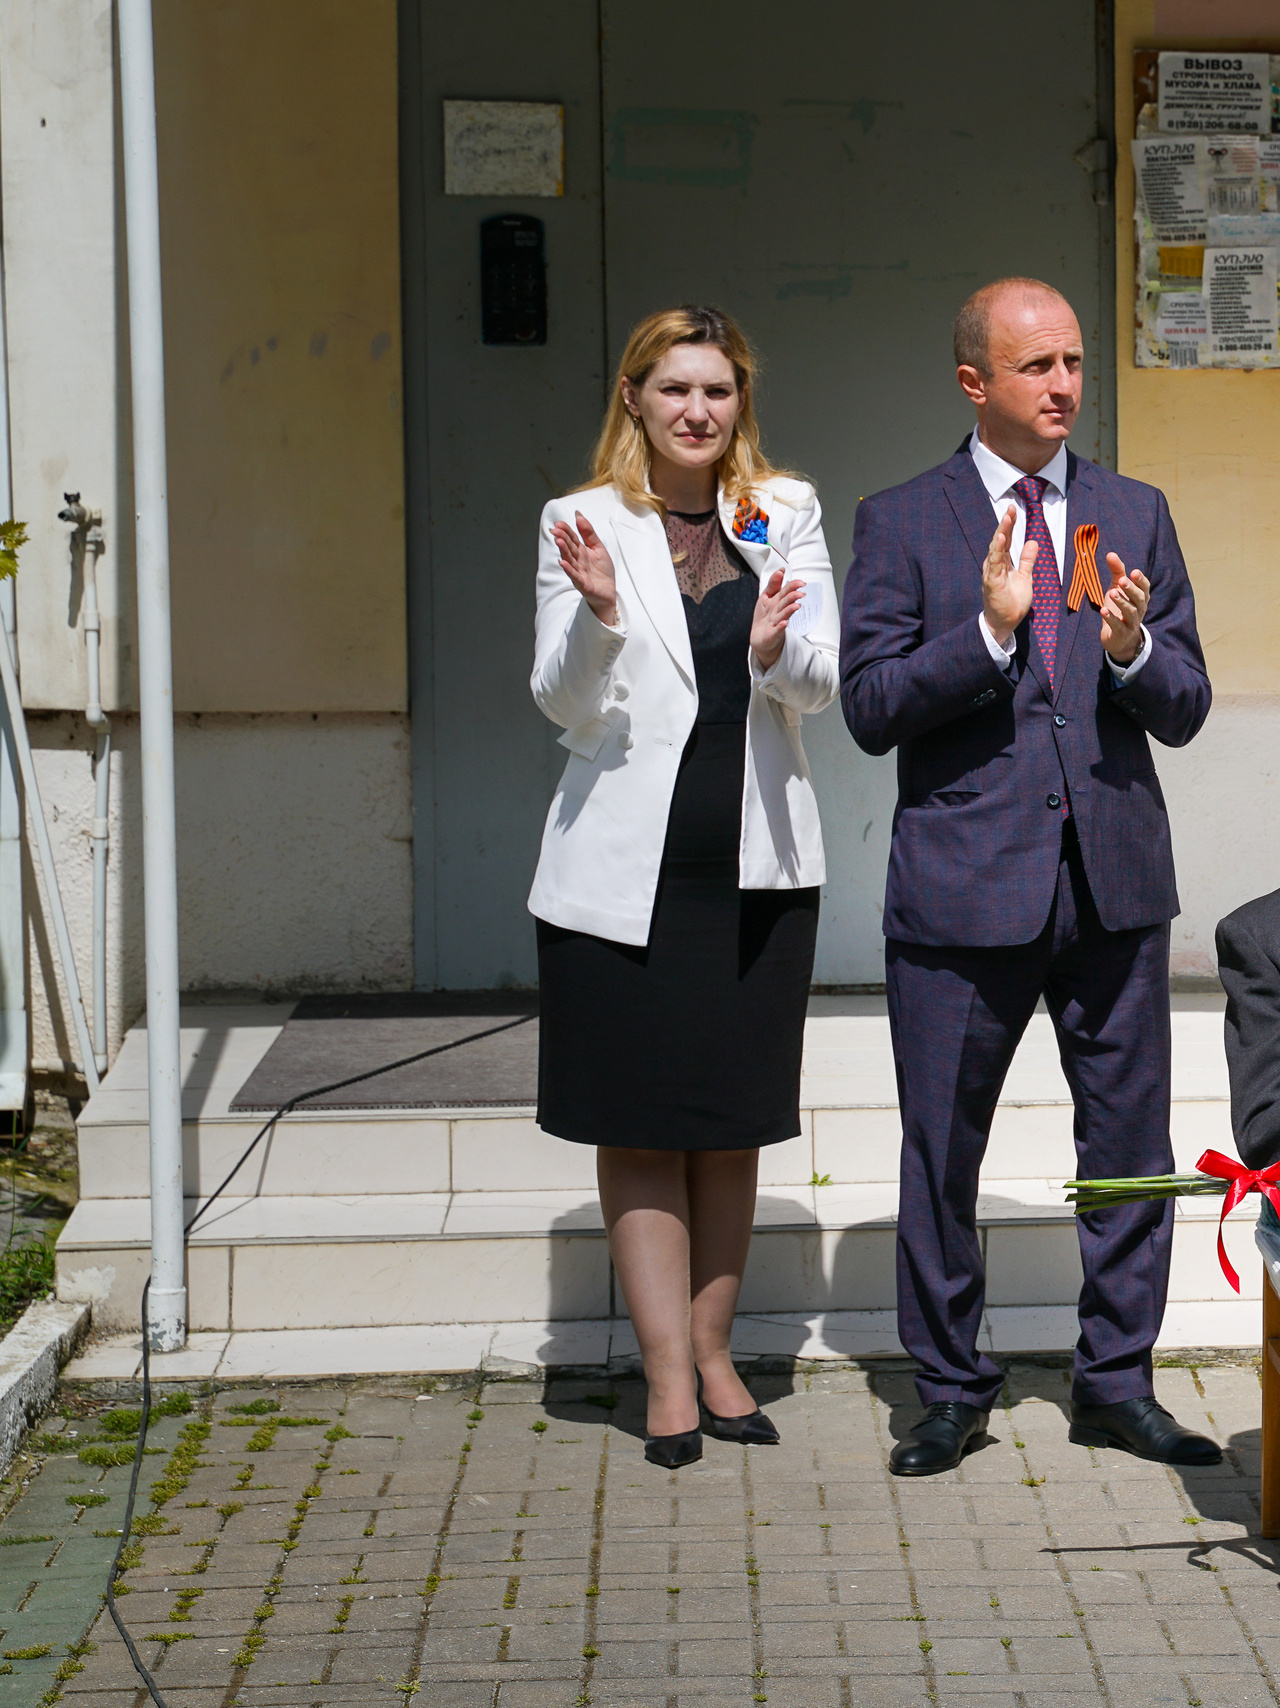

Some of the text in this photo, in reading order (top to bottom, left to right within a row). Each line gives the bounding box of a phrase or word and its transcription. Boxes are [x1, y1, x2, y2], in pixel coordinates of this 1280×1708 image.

[1184, 59, 1243, 71] ВЫВОЗ
[1172, 72, 1254, 80] СТРОИТЕЛЬНОГО
[1165, 80, 1210, 89] МУСОРА
[1223, 82, 1262, 90] ХЛАМА
[1213, 253, 1264, 264] КУПЛЮ
